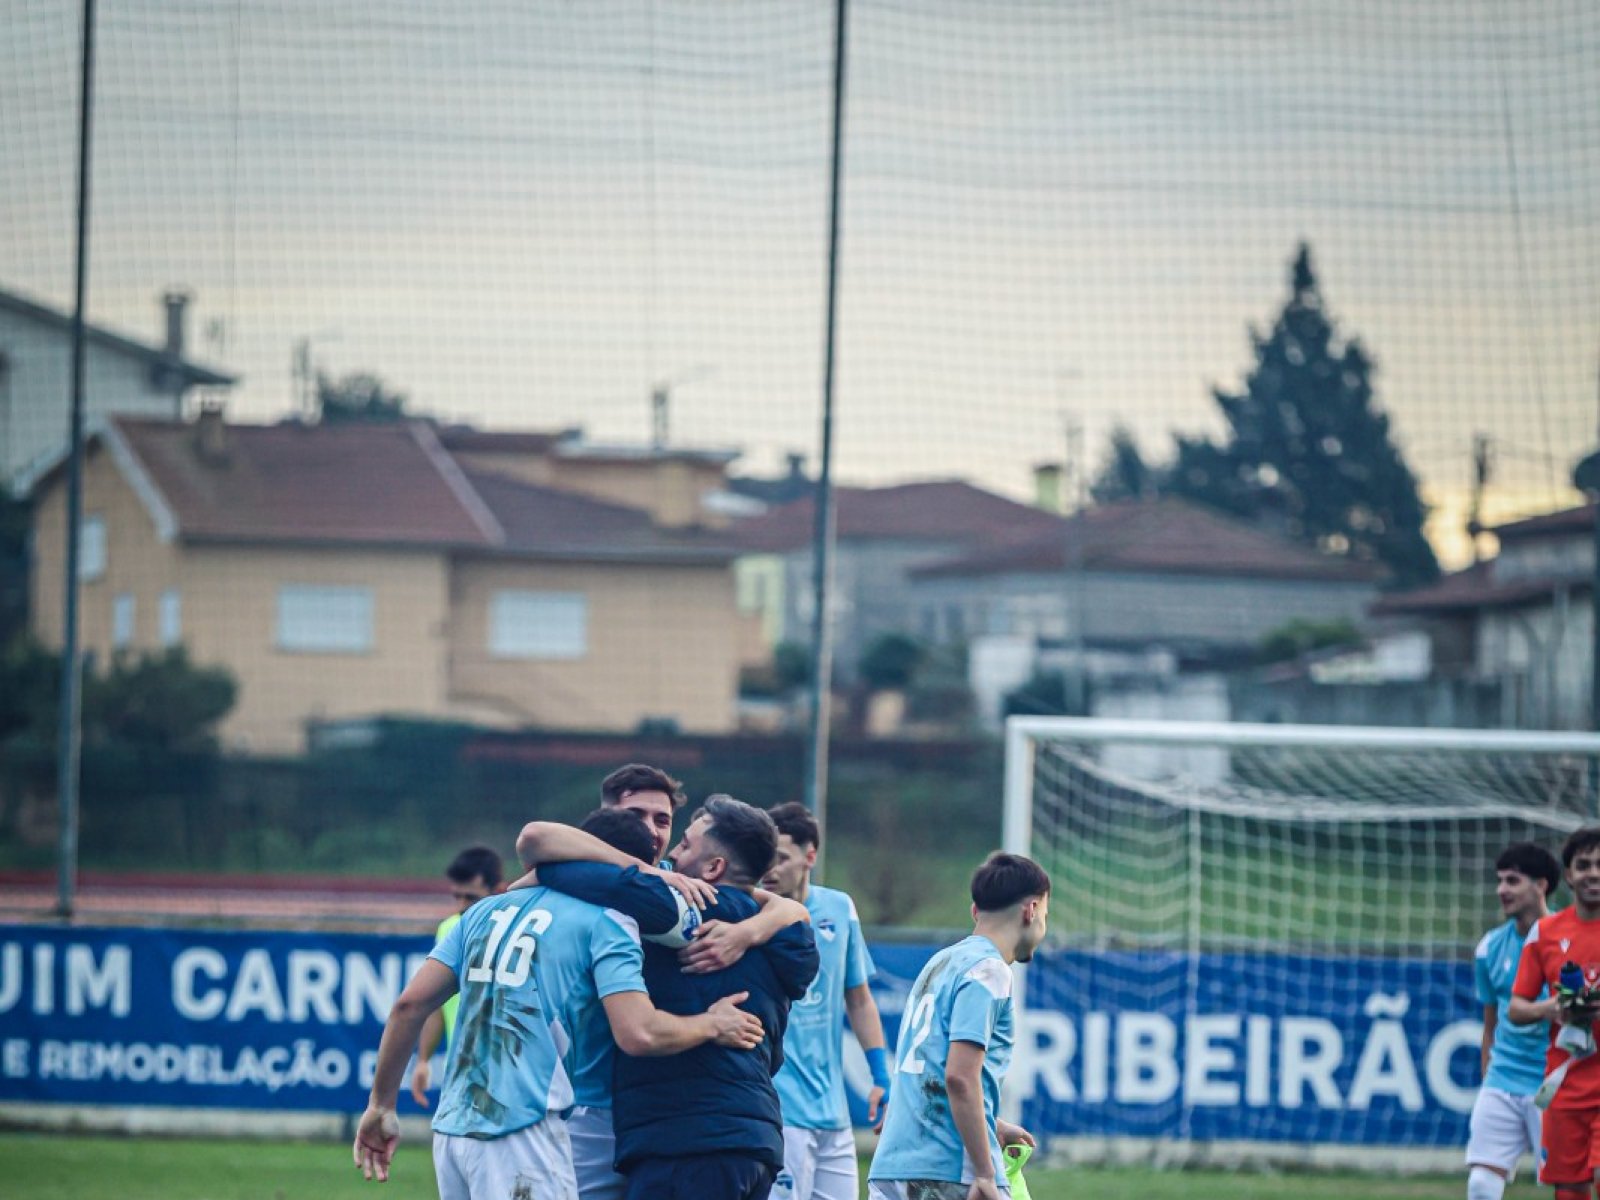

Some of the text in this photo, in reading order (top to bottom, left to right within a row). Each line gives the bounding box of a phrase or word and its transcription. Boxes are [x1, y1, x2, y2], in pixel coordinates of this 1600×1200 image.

[467, 904, 553, 988] 16
[172, 948, 429, 1024] CARN
[3, 1039, 30, 1078] E
[39, 1040, 350, 1091] REMODELAÇÃO
